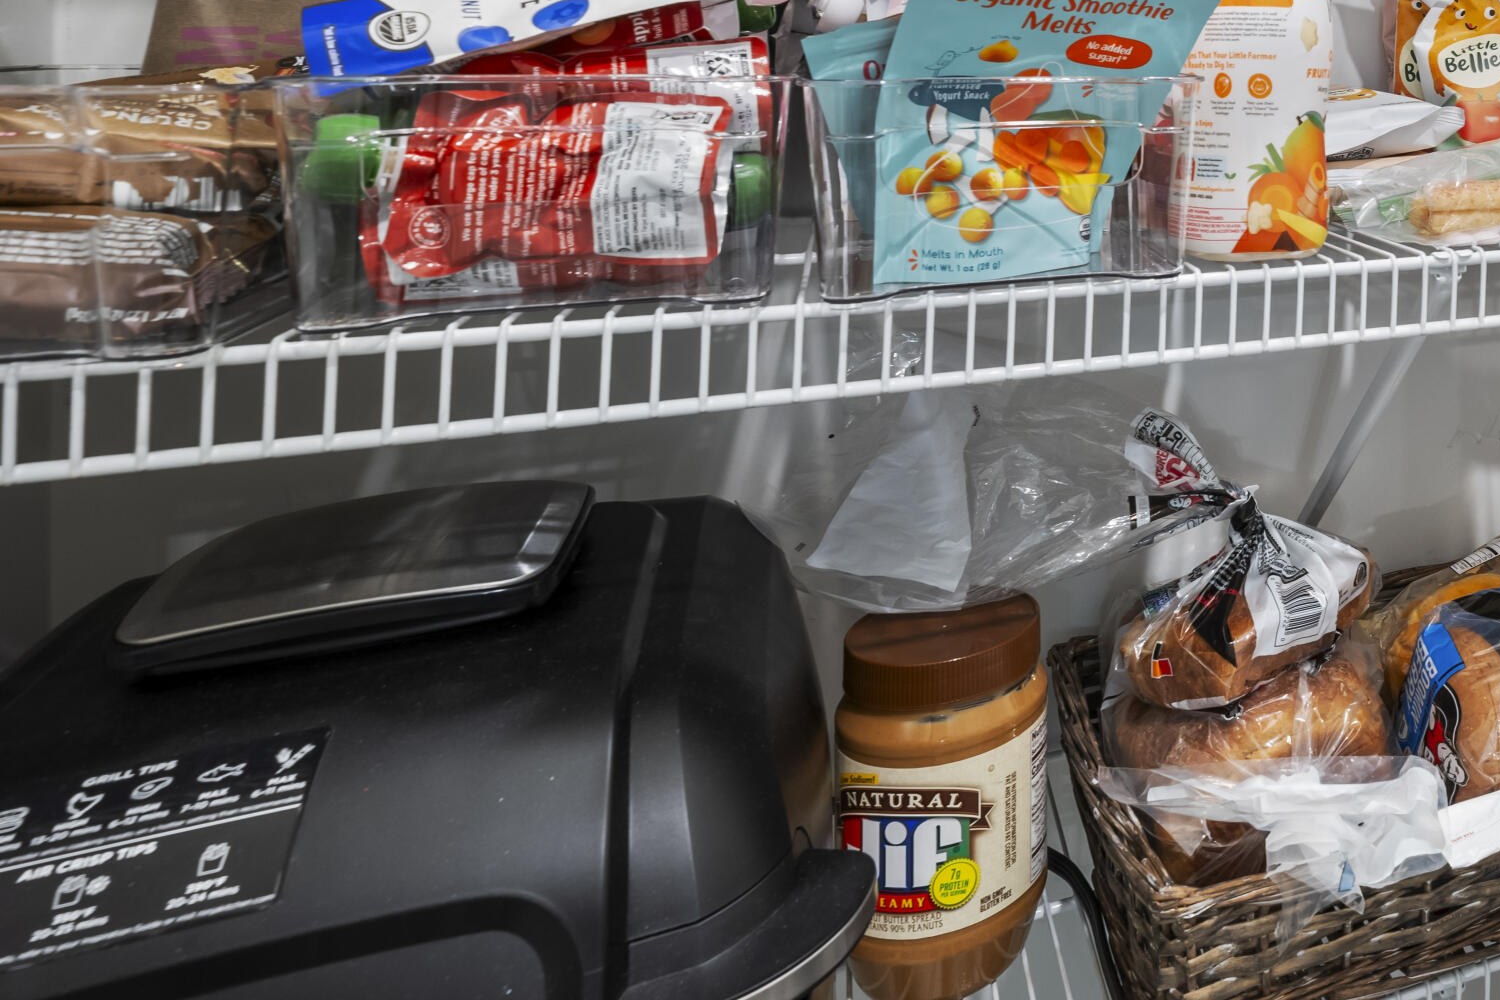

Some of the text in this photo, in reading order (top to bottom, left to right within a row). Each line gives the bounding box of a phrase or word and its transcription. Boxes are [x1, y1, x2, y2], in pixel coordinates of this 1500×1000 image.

[1022, 11, 1096, 35] Melts
[1086, 41, 1133, 56] No added
[1451, 40, 1499, 57] Little
[1213, 51, 1228, 60] Your
[1228, 51, 1247, 60] Little
[1247, 52, 1278, 61] Farmer
[1215, 61, 1225, 71] Dig
[933, 90, 991, 102] Yogurt Snack
[468, 168, 476, 182] cap
[466, 181, 476, 204] large
[489, 176, 499, 200] under
[475, 178, 485, 226] and dispose
[921, 247, 1004, 260] Melts in Mouth
[921, 263, 938, 273] Net
[939, 262, 955, 272] Wt.
[963, 263, 975, 272] oz
[81, 760, 179, 787] GRILL TIPS
[850, 775, 876, 785] Sodium!
[846, 791, 963, 809] NATURAL
[15, 841, 159, 884] AIR CRISP TIPS
[950, 868, 962, 880] 7g
[939, 879, 970, 891] PROTEIN
[980, 888, 1013, 913] GLUTEN FREE
[980, 896, 991, 906] NON
[884, 912, 942, 925] BUTTER SPREAD
[889, 920, 944, 933] 90% PEANUTS
